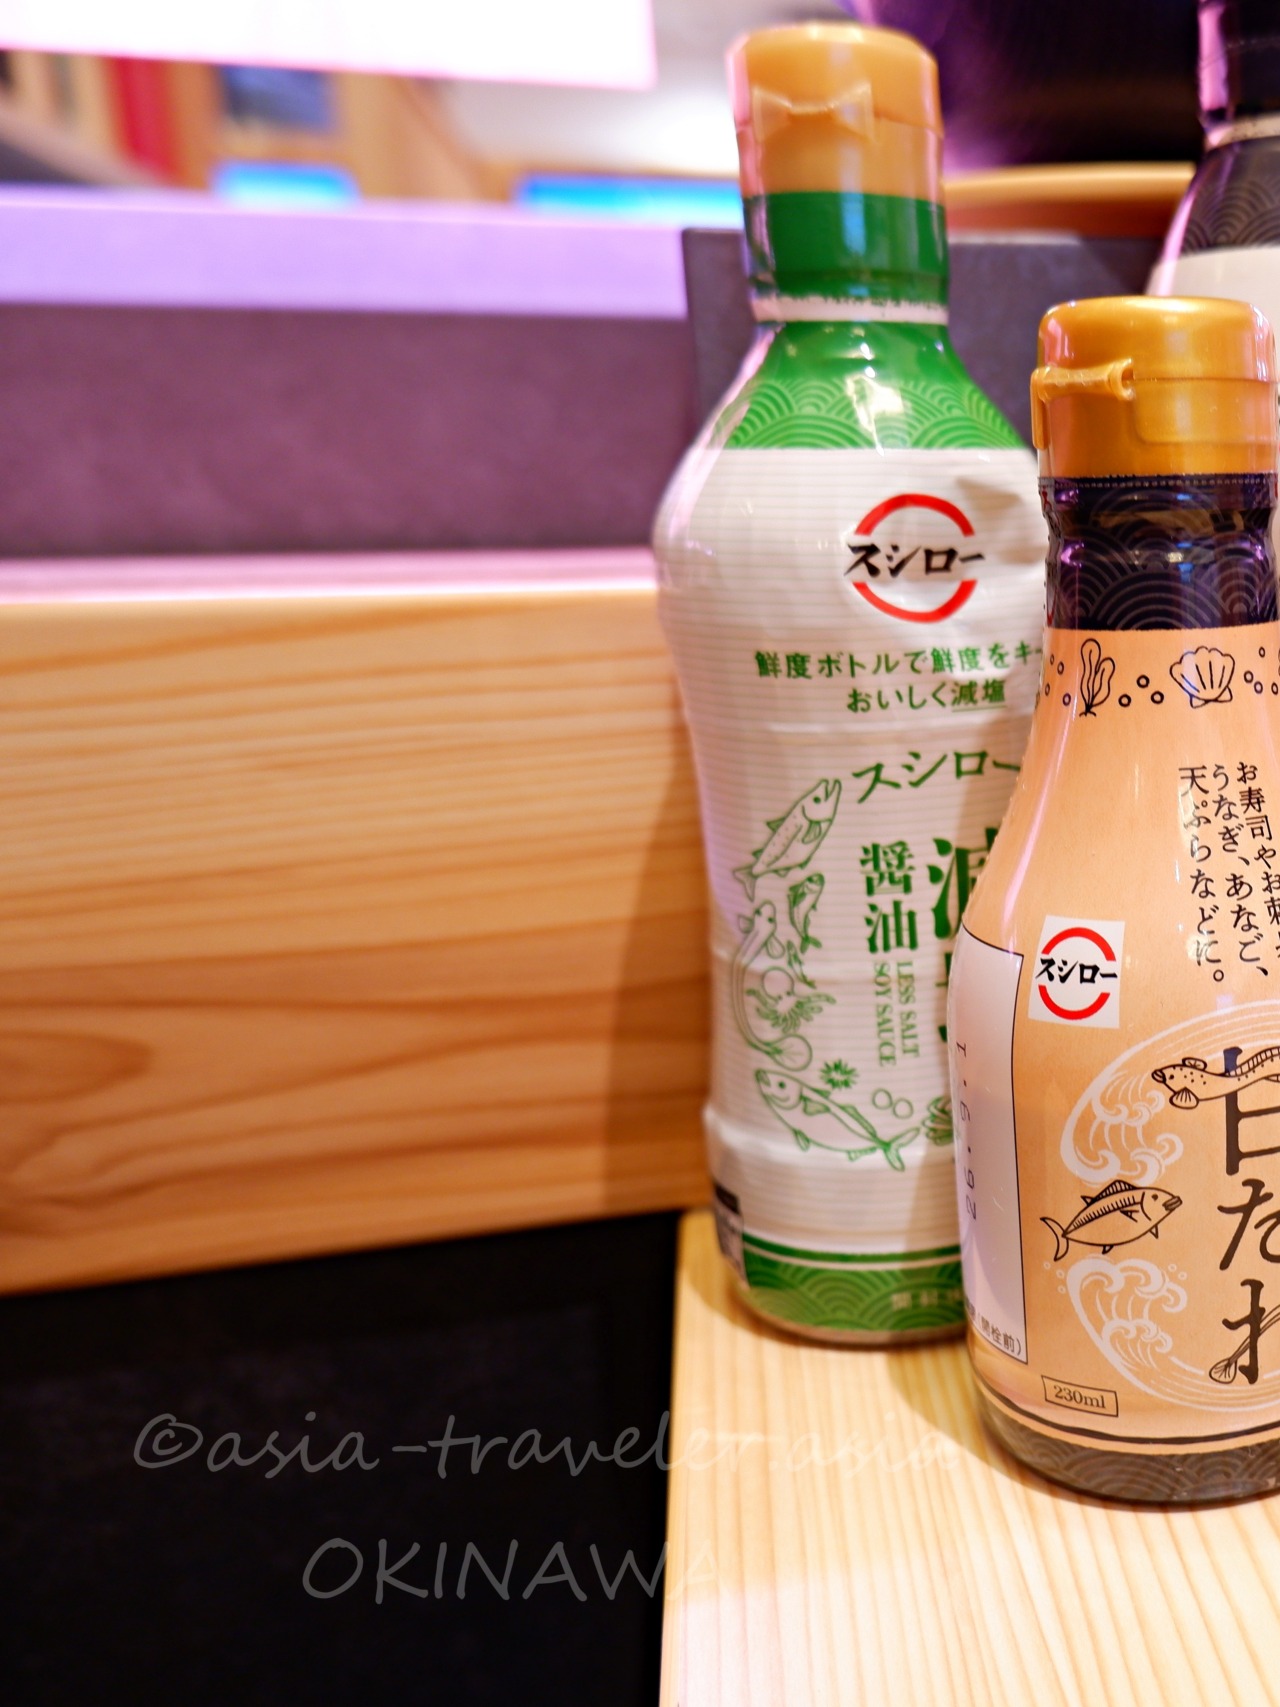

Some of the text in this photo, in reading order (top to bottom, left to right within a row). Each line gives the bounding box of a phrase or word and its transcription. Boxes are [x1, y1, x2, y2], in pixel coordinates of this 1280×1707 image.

[844, 543, 985, 577] スシロー
[852, 750, 1021, 804] スシロー
[860, 840, 919, 954] 醤油
[1035, 957, 1118, 984] スシロー
[874, 961, 897, 1067] SOY SAUCE
[896, 961, 920, 1058] LESS SALT
[1053, 1384, 1107, 1409] 230ml
